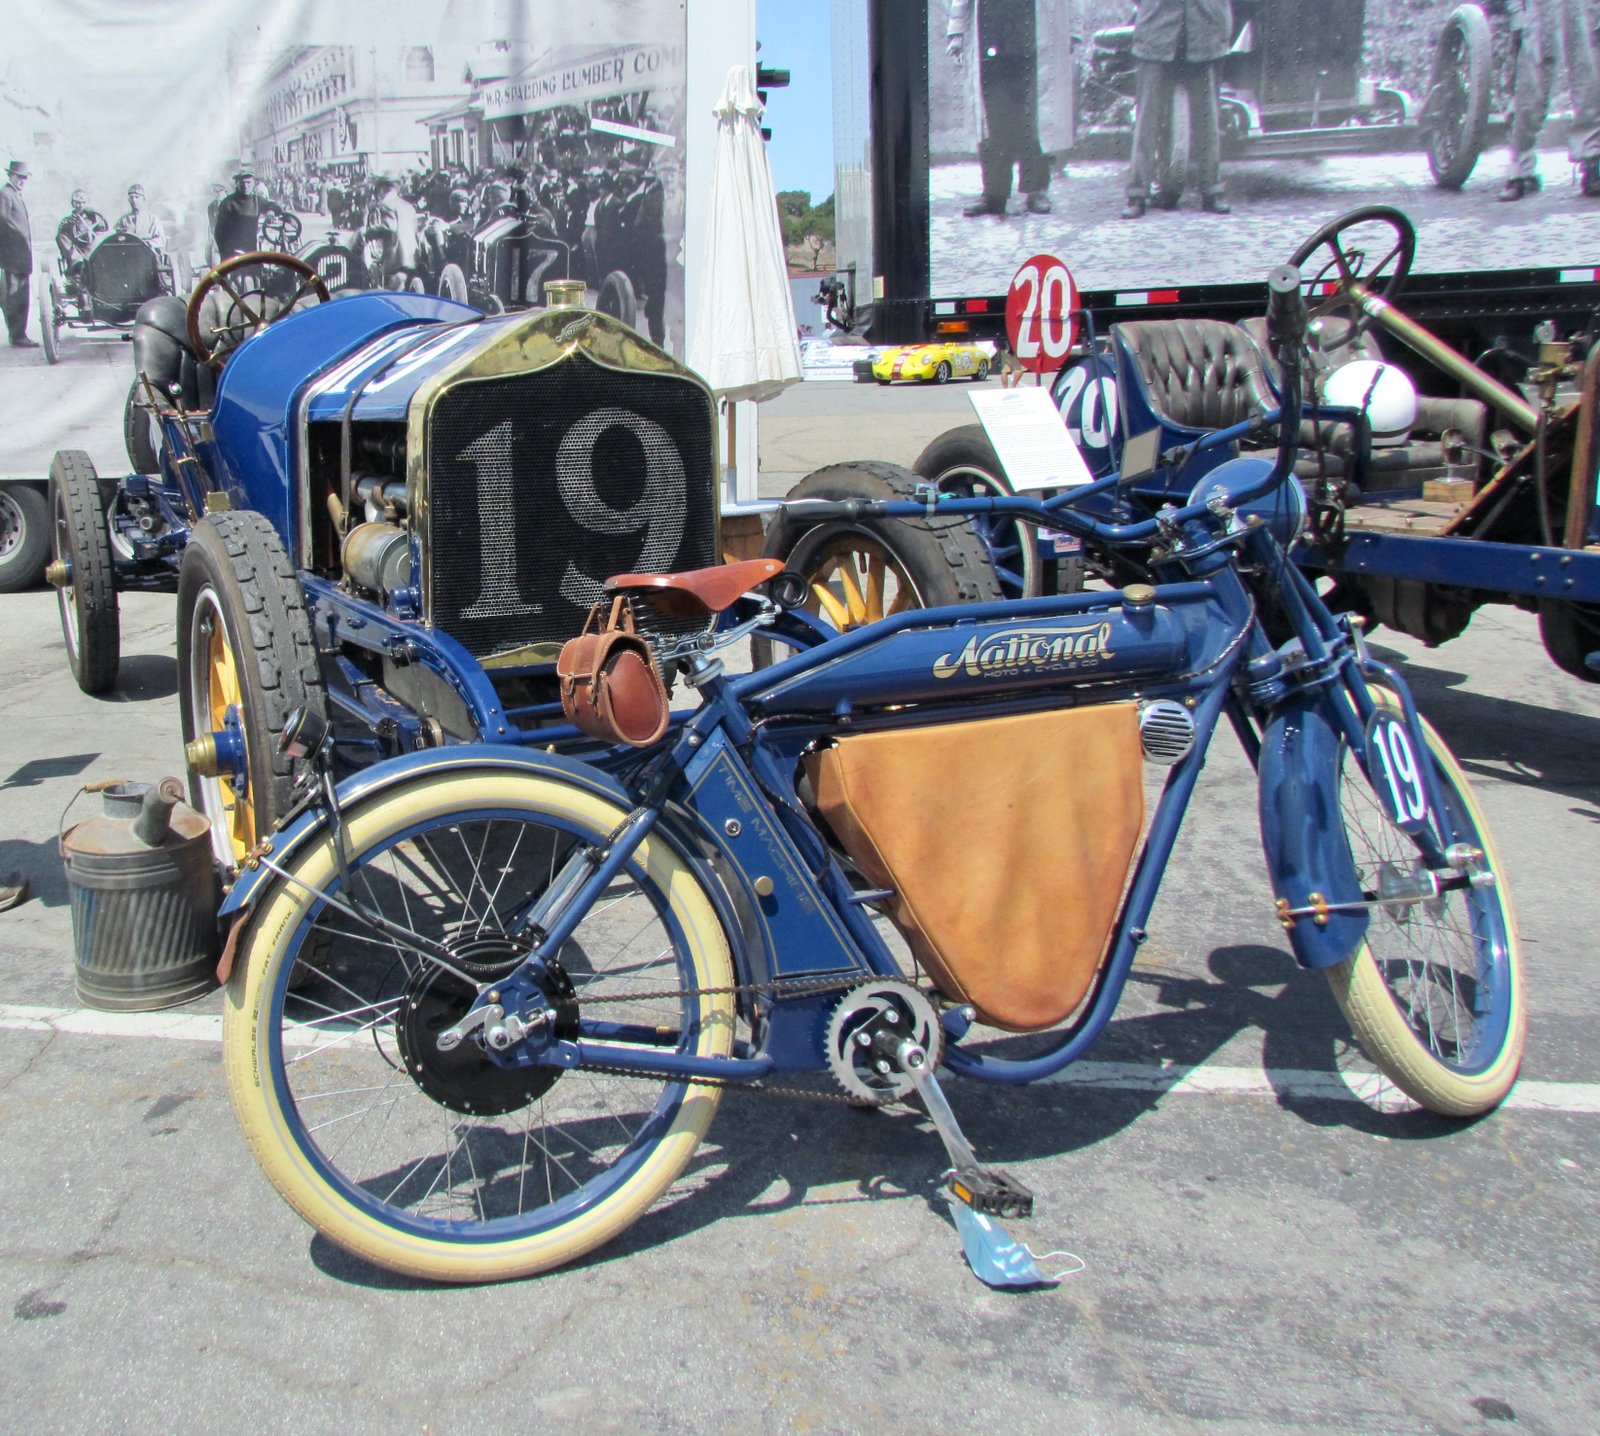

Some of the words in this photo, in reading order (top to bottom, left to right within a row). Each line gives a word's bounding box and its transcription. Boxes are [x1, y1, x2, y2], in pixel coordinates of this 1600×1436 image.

[504, 76, 557, 105] SPALDING
[562, 57, 625, 91] LUMBER
[1014, 264, 1072, 358] 20
[1056, 365, 1118, 449] 20
[455, 406, 687, 620] 19
[932, 620, 1117, 679] National
[983, 668, 1019, 678] MOTO
[1035, 661, 1077, 673] CYCLE
[1082, 659, 1099, 667] CO
[1372, 720, 1426, 824] 19
[250, 1026, 260, 1088] SCHWALBE
[262, 953, 271, 975] FAT
[272, 909, 292, 947] FRANK
